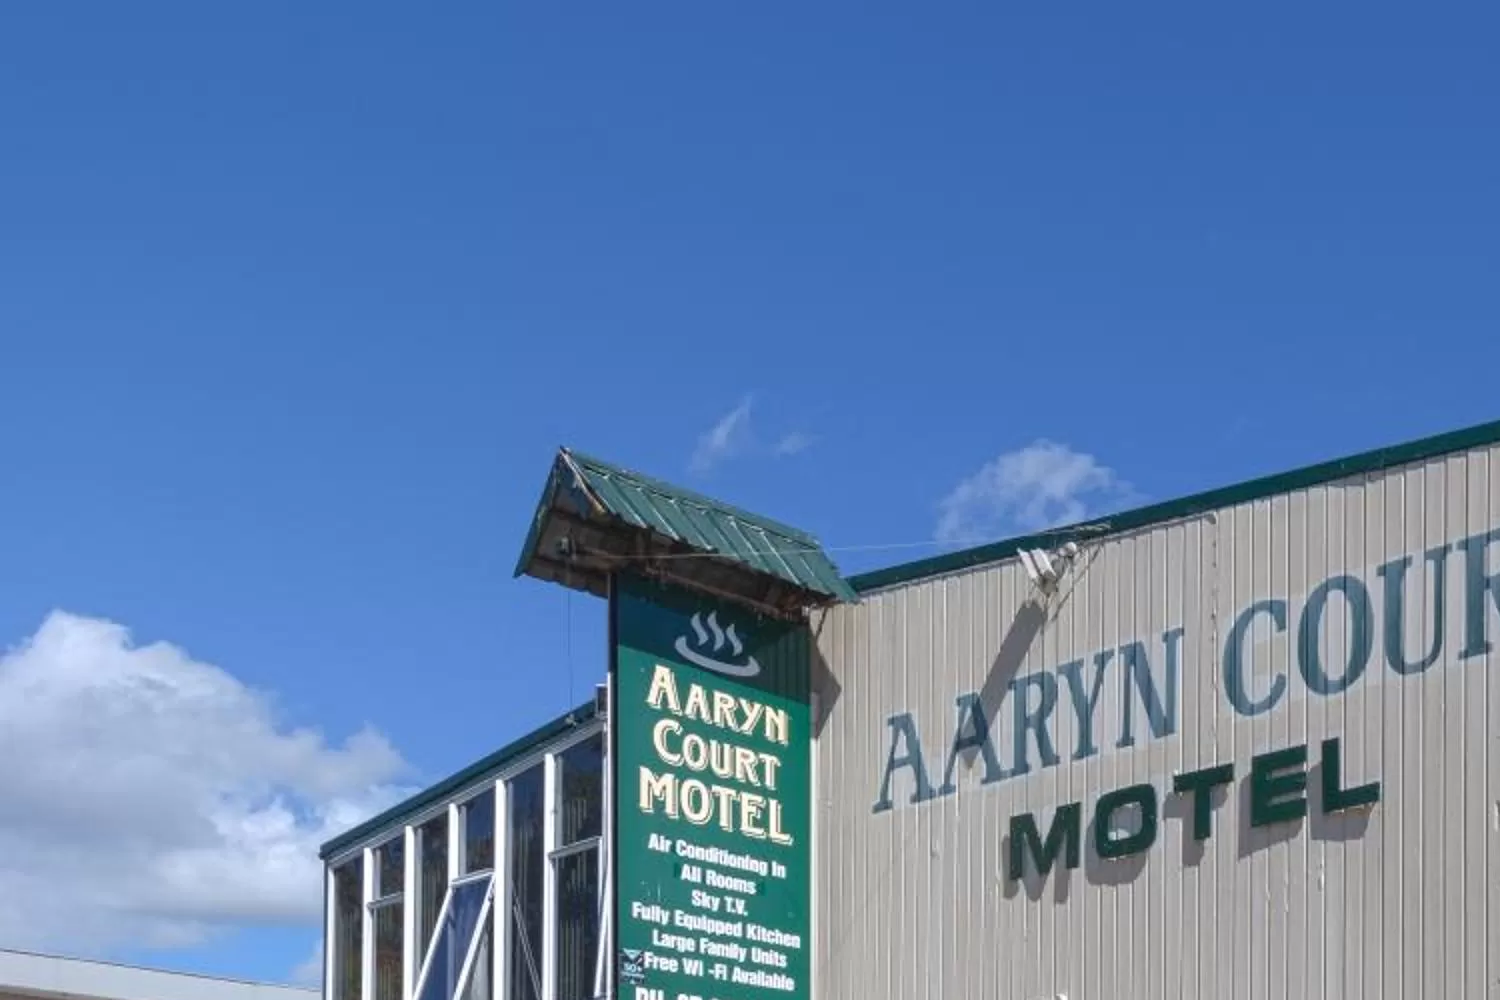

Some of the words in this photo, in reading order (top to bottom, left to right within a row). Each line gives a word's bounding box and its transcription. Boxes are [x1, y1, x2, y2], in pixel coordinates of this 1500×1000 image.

[646, 664, 789, 747] AARYN
[871, 625, 1186, 814] AARYN
[653, 718, 781, 790] COURT
[639, 766, 793, 845] MOTEL
[1008, 737, 1381, 881] MOTEL
[647, 833, 672, 852] Air
[675, 839, 768, 877] Conditioning
[681, 863, 702, 883] All
[705, 869, 757, 895] Rooms
[691, 889, 720, 912] Sky
[724, 895, 748, 916] T.V.
[632, 901, 670, 925] Fully
[675, 909, 743, 937] Equipped
[746, 923, 801, 948] Kitchen
[644, 952, 679, 973] Free
[732, 966, 795, 992] Available
[653, 929, 696, 953] Large
[699, 937, 747, 962] Family
[751, 947, 788, 968] Units
